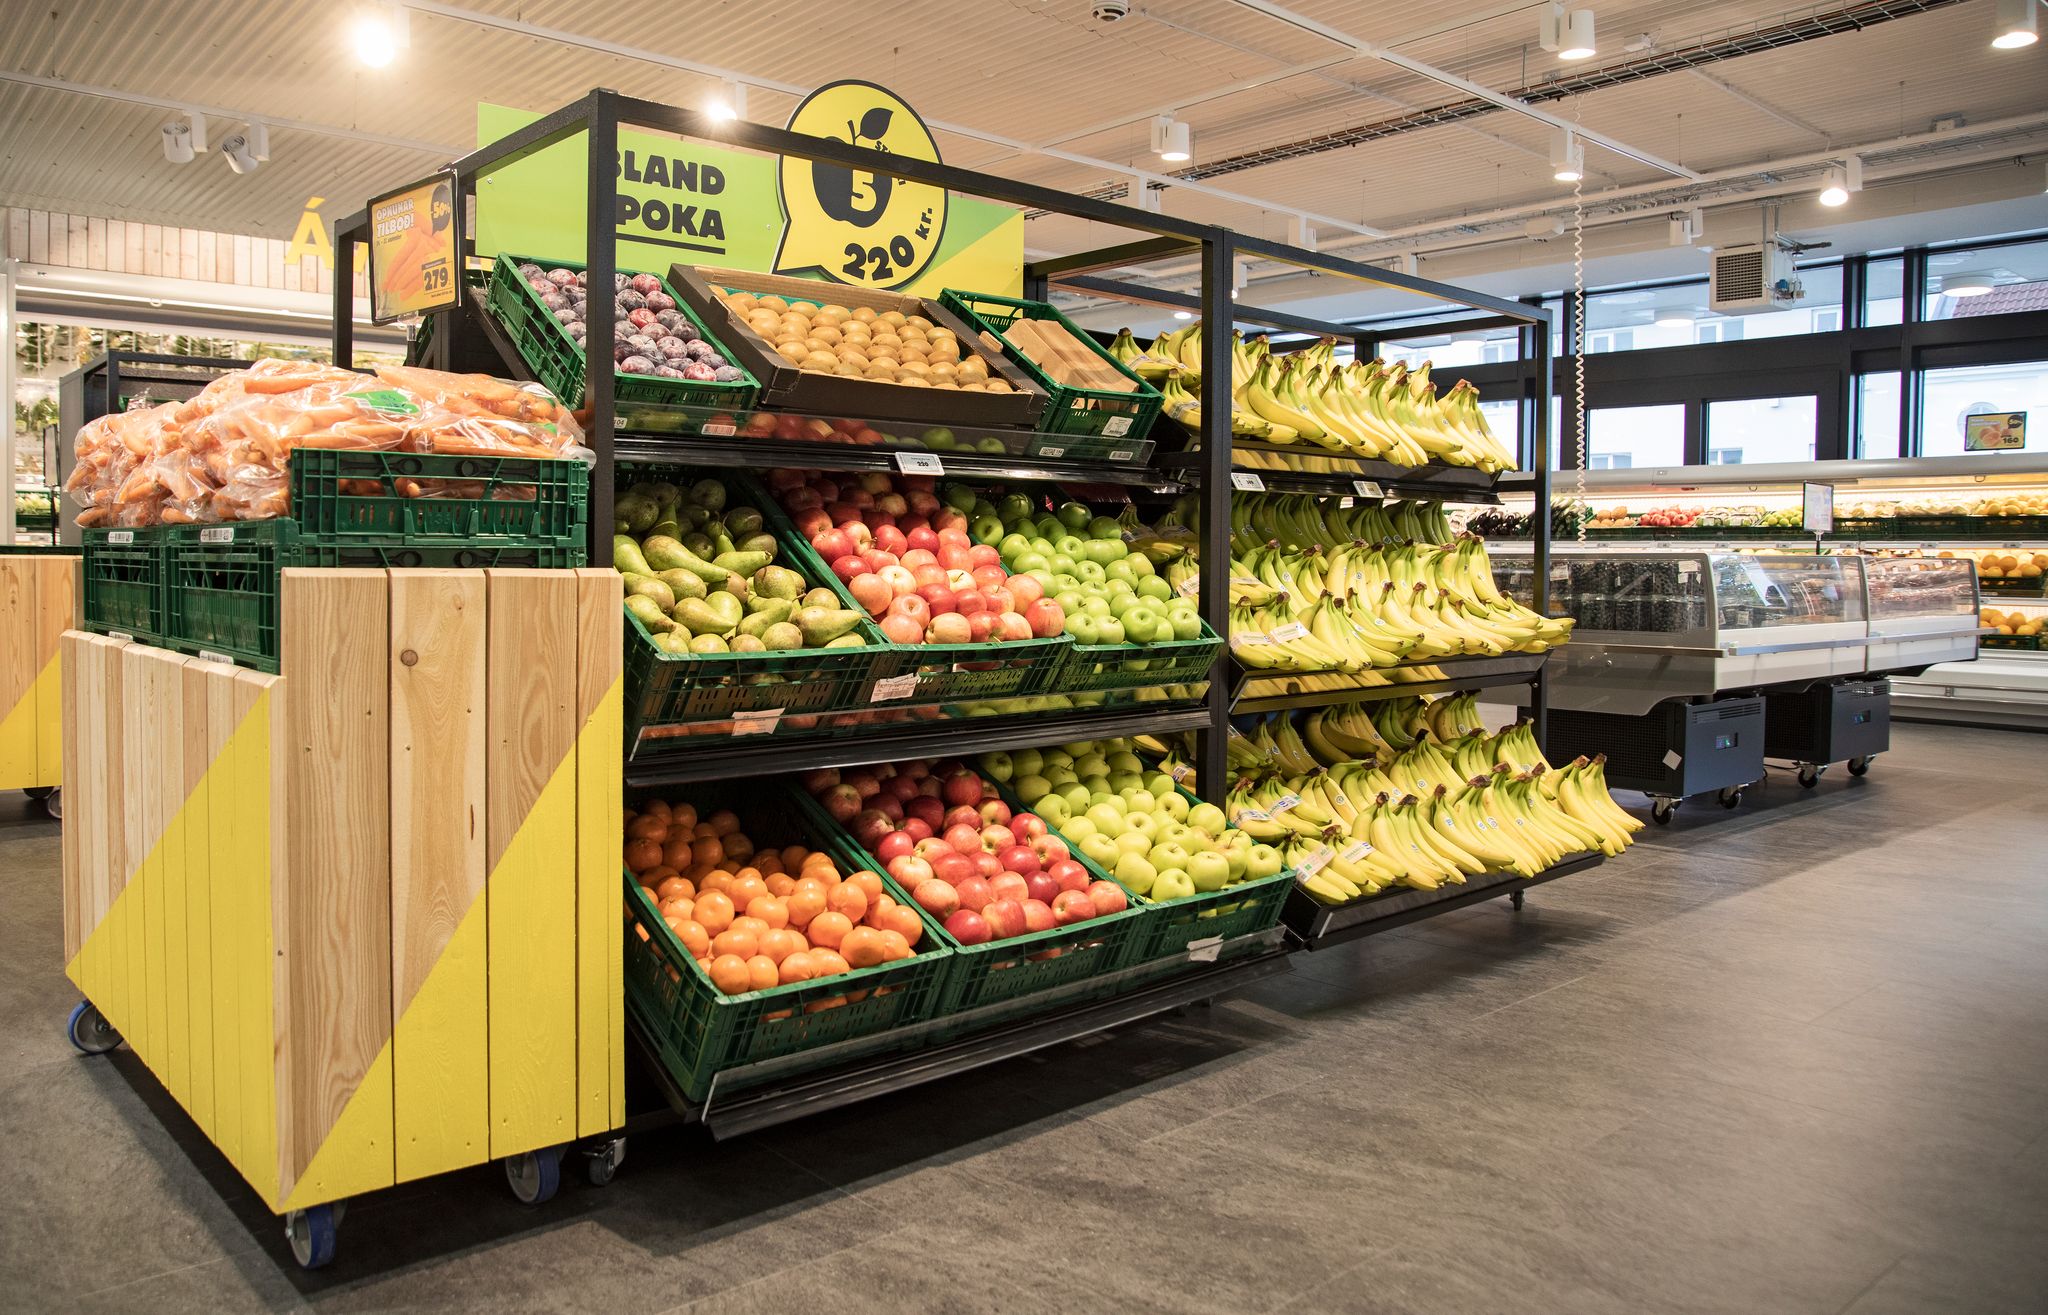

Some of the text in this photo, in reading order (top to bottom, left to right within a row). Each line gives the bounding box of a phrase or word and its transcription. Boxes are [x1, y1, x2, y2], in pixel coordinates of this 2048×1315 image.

[851, 170, 877, 212] 5
[616, 194, 725, 240] POKA
[842, 207, 933, 281] 220 kr.
[424, 267, 449, 291] 279
